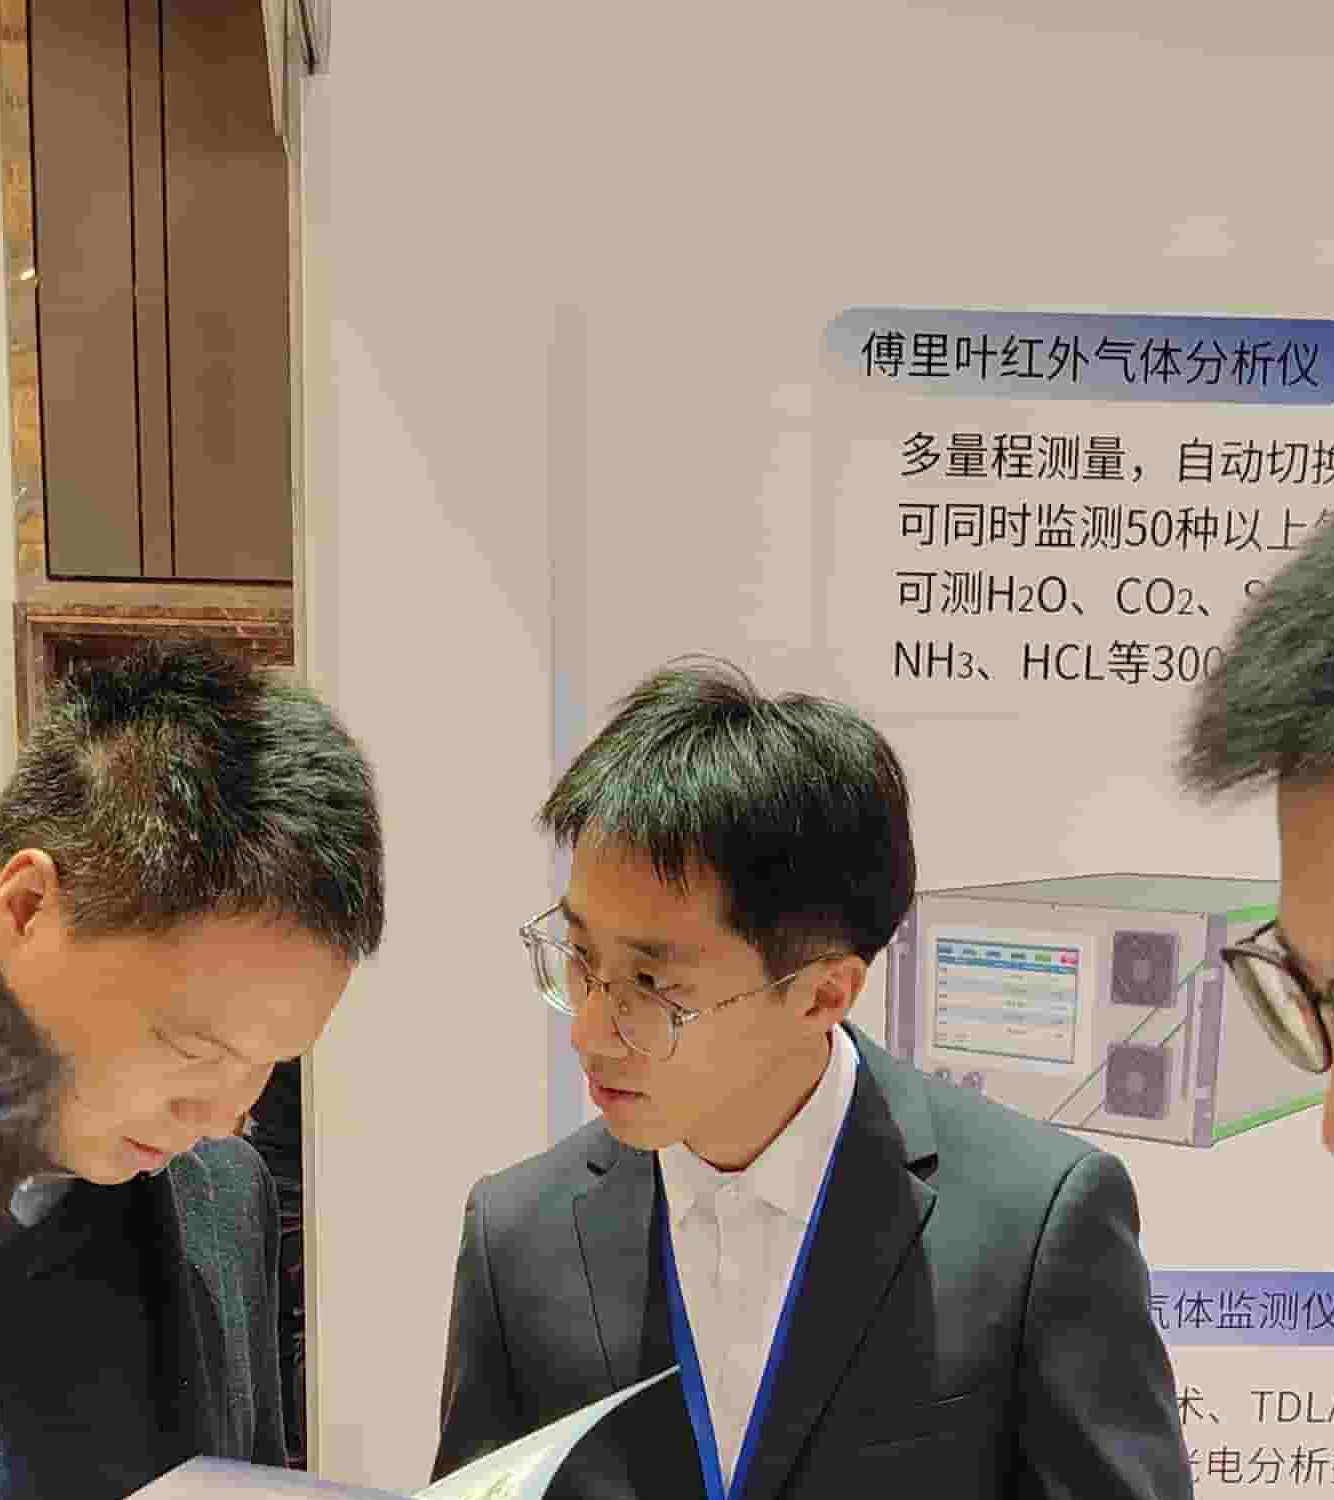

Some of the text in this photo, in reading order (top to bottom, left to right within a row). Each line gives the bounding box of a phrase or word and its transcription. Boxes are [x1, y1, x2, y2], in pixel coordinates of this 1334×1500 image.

[860, 329, 1321, 388] 傅里叶红外气体分析仪
